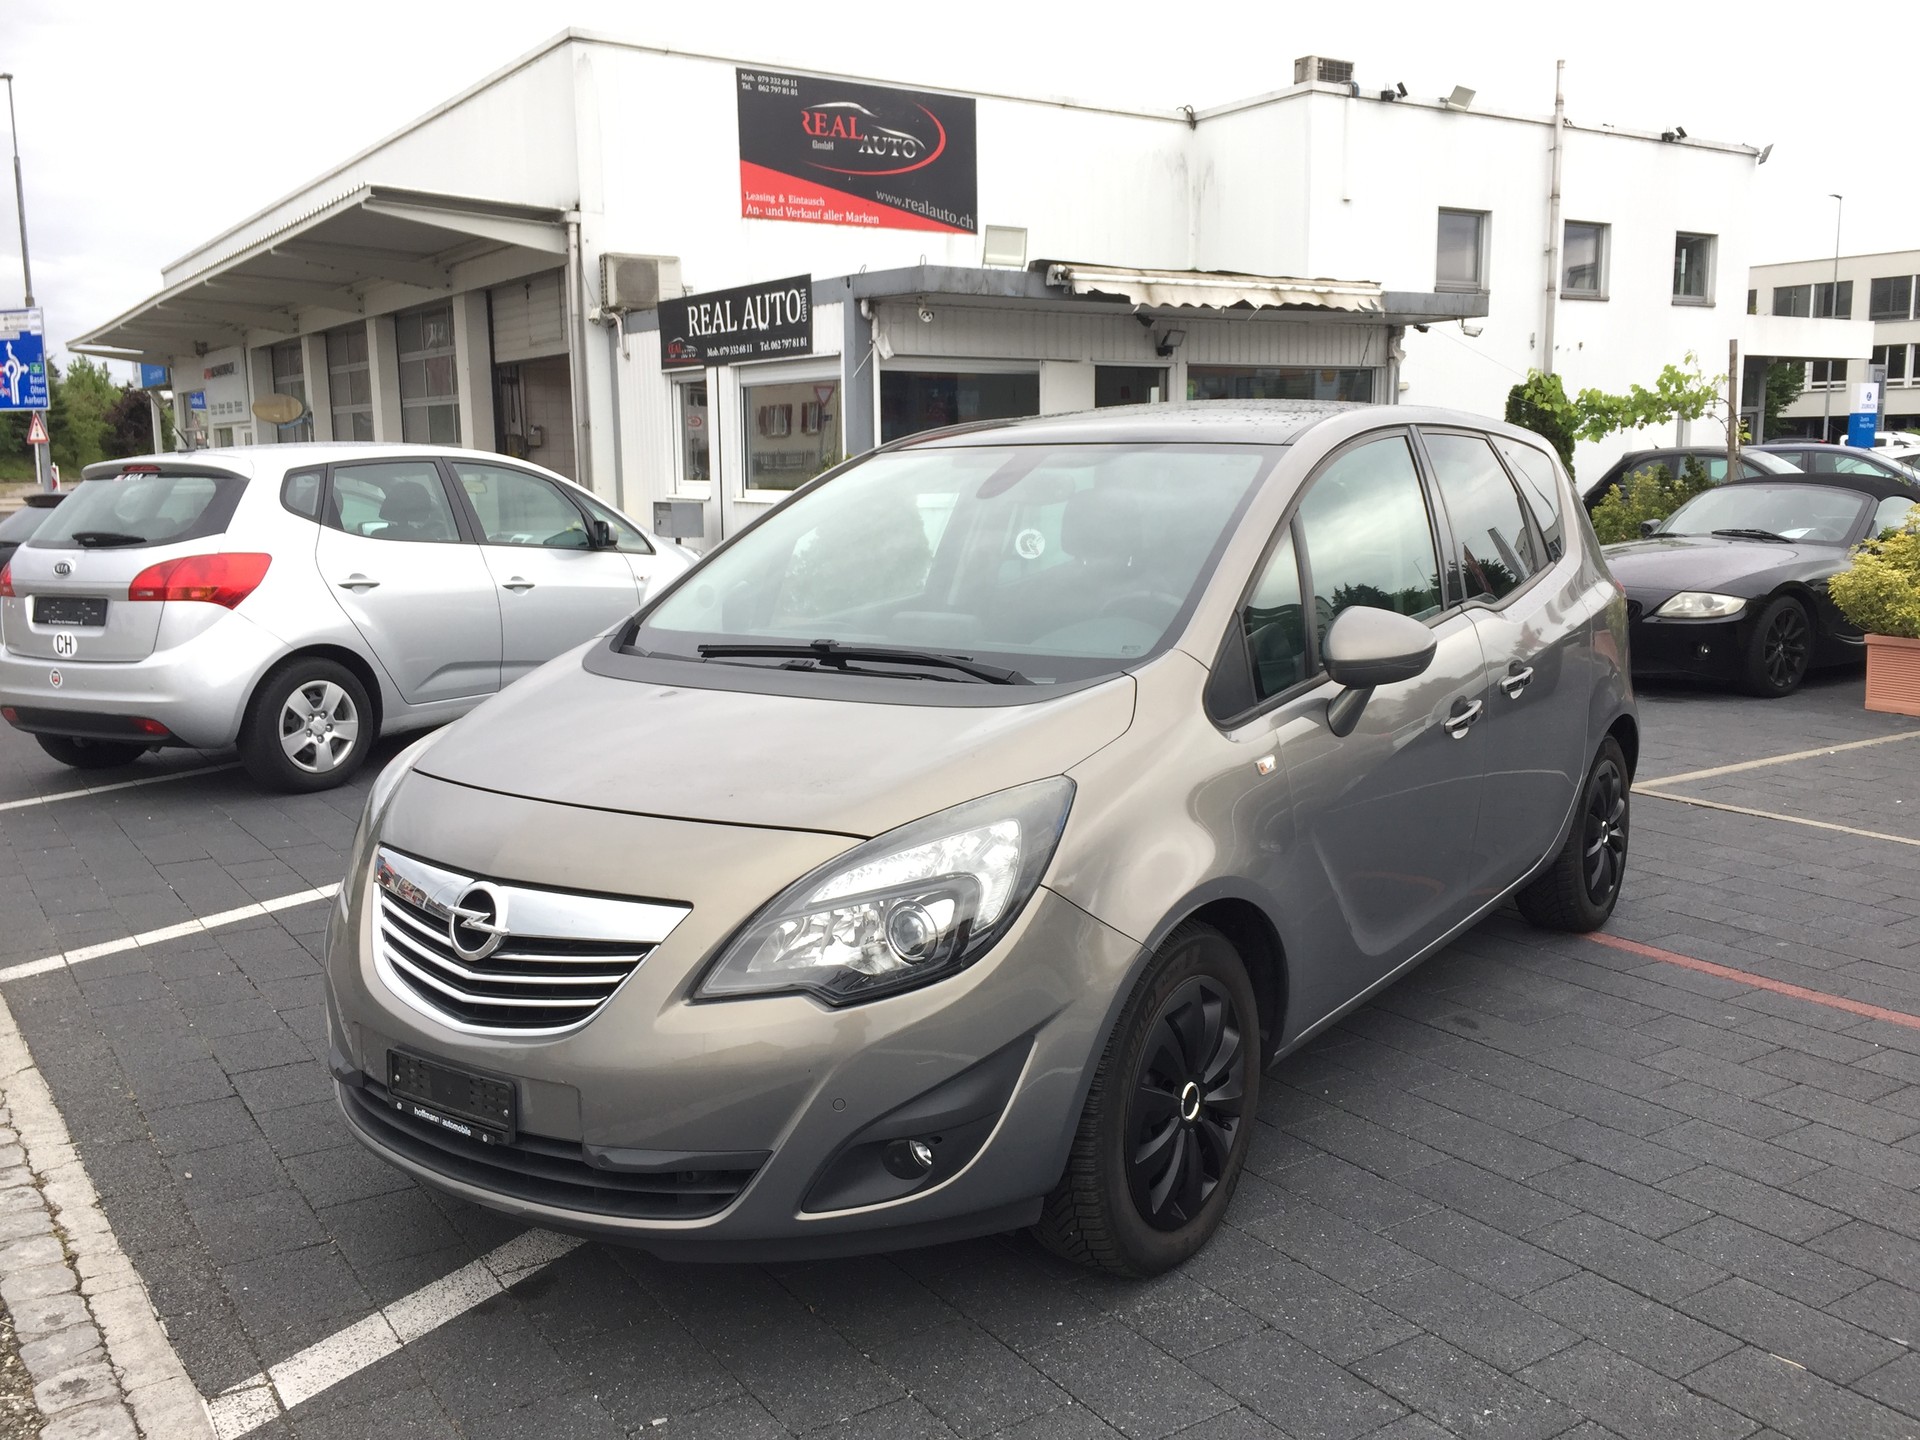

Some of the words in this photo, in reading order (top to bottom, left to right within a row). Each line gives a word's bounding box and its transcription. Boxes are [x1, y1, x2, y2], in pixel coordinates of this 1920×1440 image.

[741, 73, 755, 82] Mob.
[757, 75, 769, 83] 079
[770, 77, 780, 85] 332
[742, 82, 752, 90] Tel.
[758, 84, 769, 92] 062
[782, 87, 789, 95] 81
[790, 88, 798, 96] 81
[801, 111, 864, 140] REAL
[811, 139, 834, 151] GmbH
[858, 134, 917, 159] AUTO
[745, 191, 775, 204] Leasing
[778, 194, 785, 203] &
[788, 194, 825, 206] Eintausch
[746, 203, 763, 215] An-
[765, 206, 784, 216] und
[785, 206, 822, 220] Verkauf
[823, 209, 844, 221] aller
[845, 211, 880, 224] Marken
[876, 190, 974, 230] www.realauto.ch
[687, 300, 738, 337] REAL
[741, 289, 801, 331] AUTO
[706, 346, 719, 357] Mob.
[719, 346, 729, 356] 079
[729, 345, 739, 355] 332
[746, 343, 753, 353] 11
[760, 341, 770, 351] Tel.
[770, 340, 780, 350] 062
[781, 339, 792, 349] 797
[792, 338, 799, 348] 81
[800, 336, 808, 347] 81
[29, 375, 45, 385] Basel
[30, 385, 46, 395] Olten
[24, 395, 47, 406] Aarburg
[56, 564, 69, 573] KIA
[57, 634, 73, 655] CH
[414, 1106, 440, 1123] hoffmann
[441, 1118, 472, 1137] automobile
